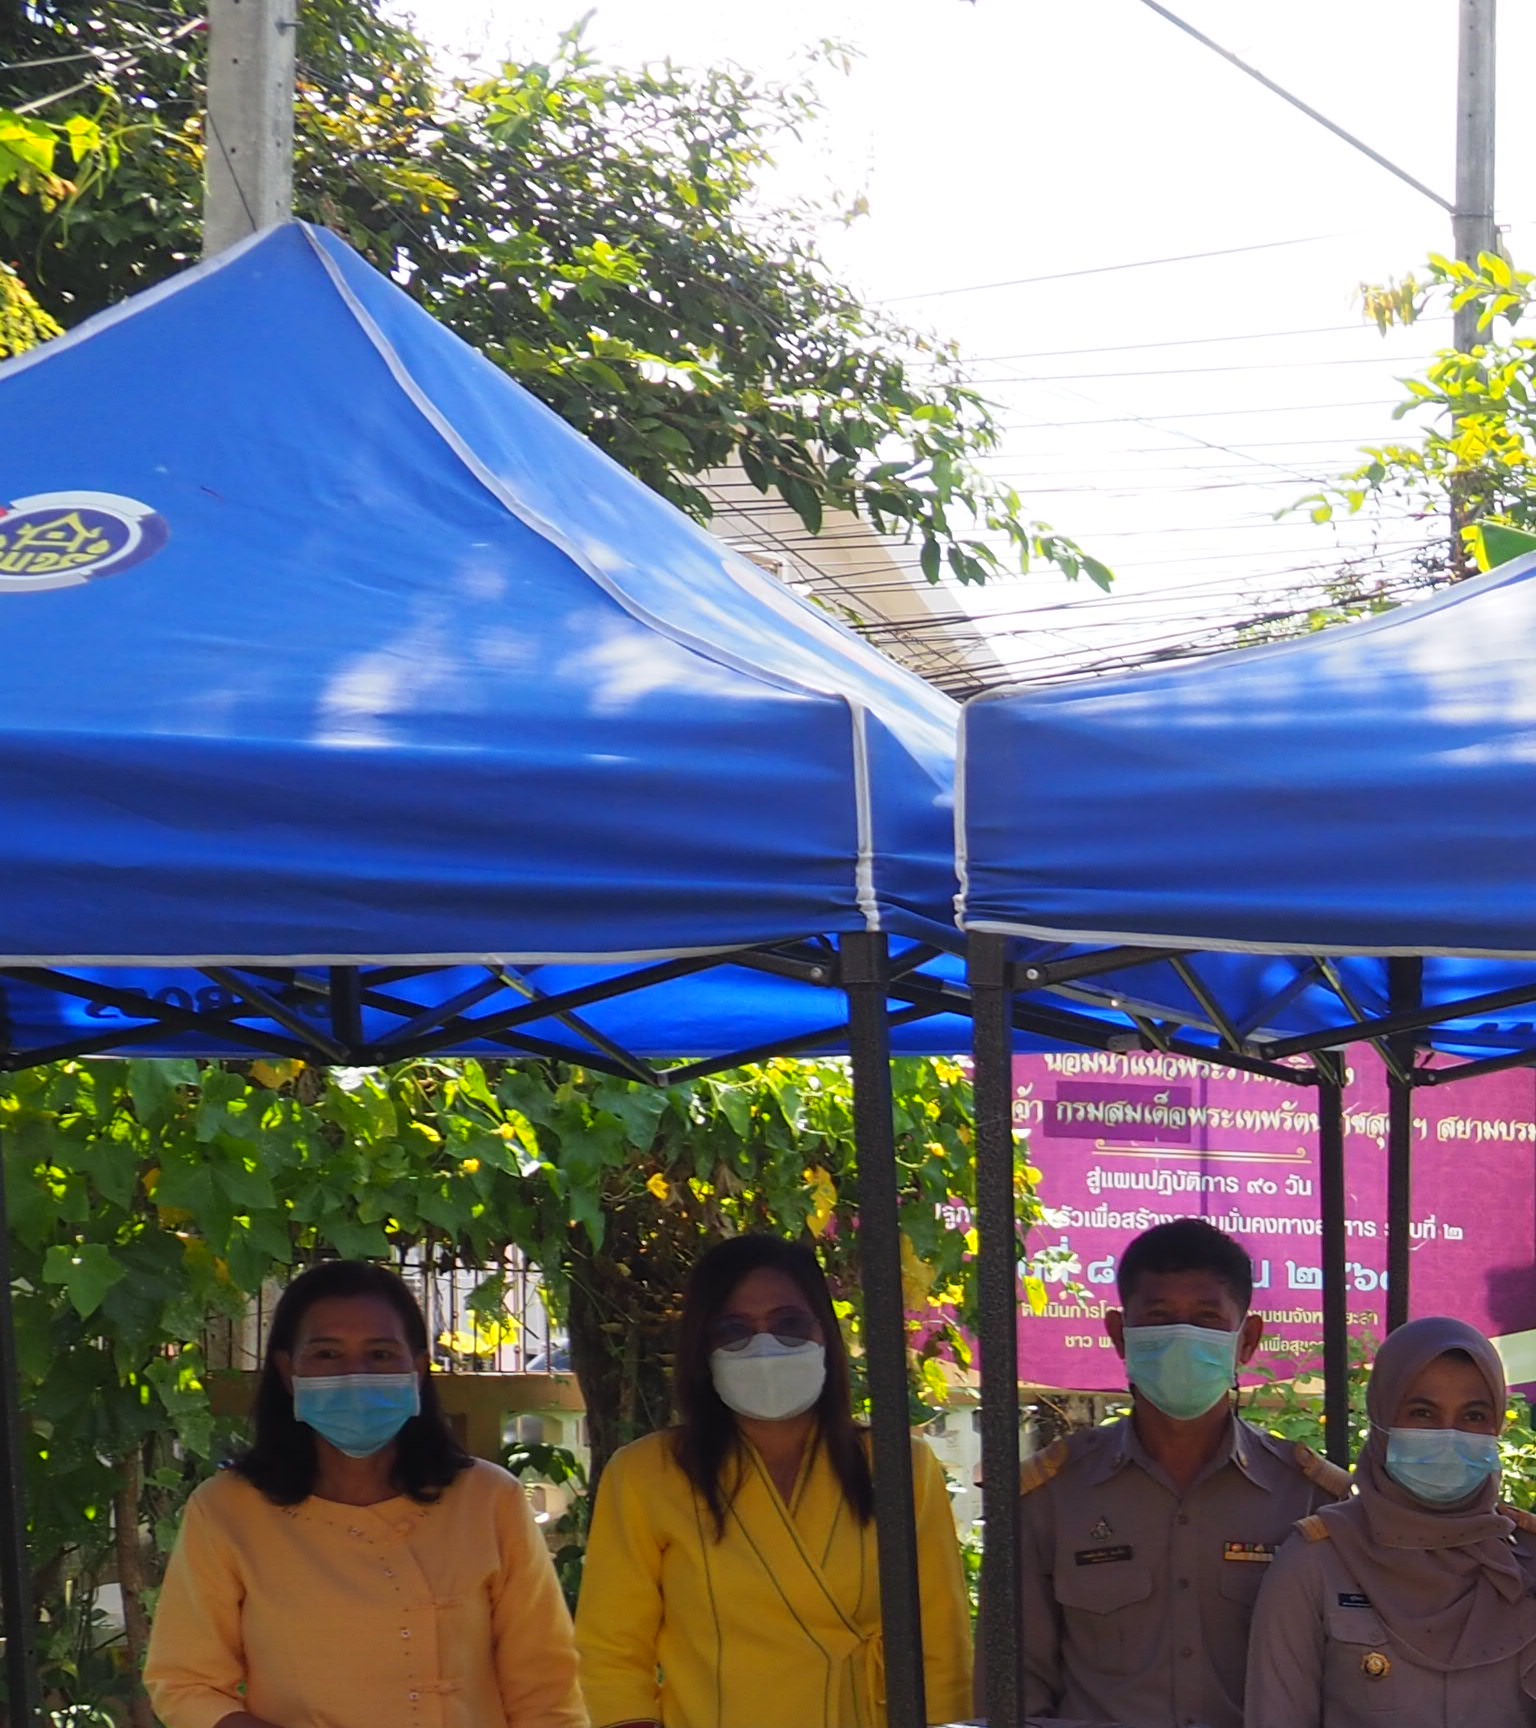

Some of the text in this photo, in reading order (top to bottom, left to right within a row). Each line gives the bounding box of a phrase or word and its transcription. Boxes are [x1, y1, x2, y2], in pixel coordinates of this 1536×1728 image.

[1086, 1166, 1312, 1196] สู่แผนปฏิบัติการ ๙๐ วัน
[1443, 1224, 1463, 1240] ๒
